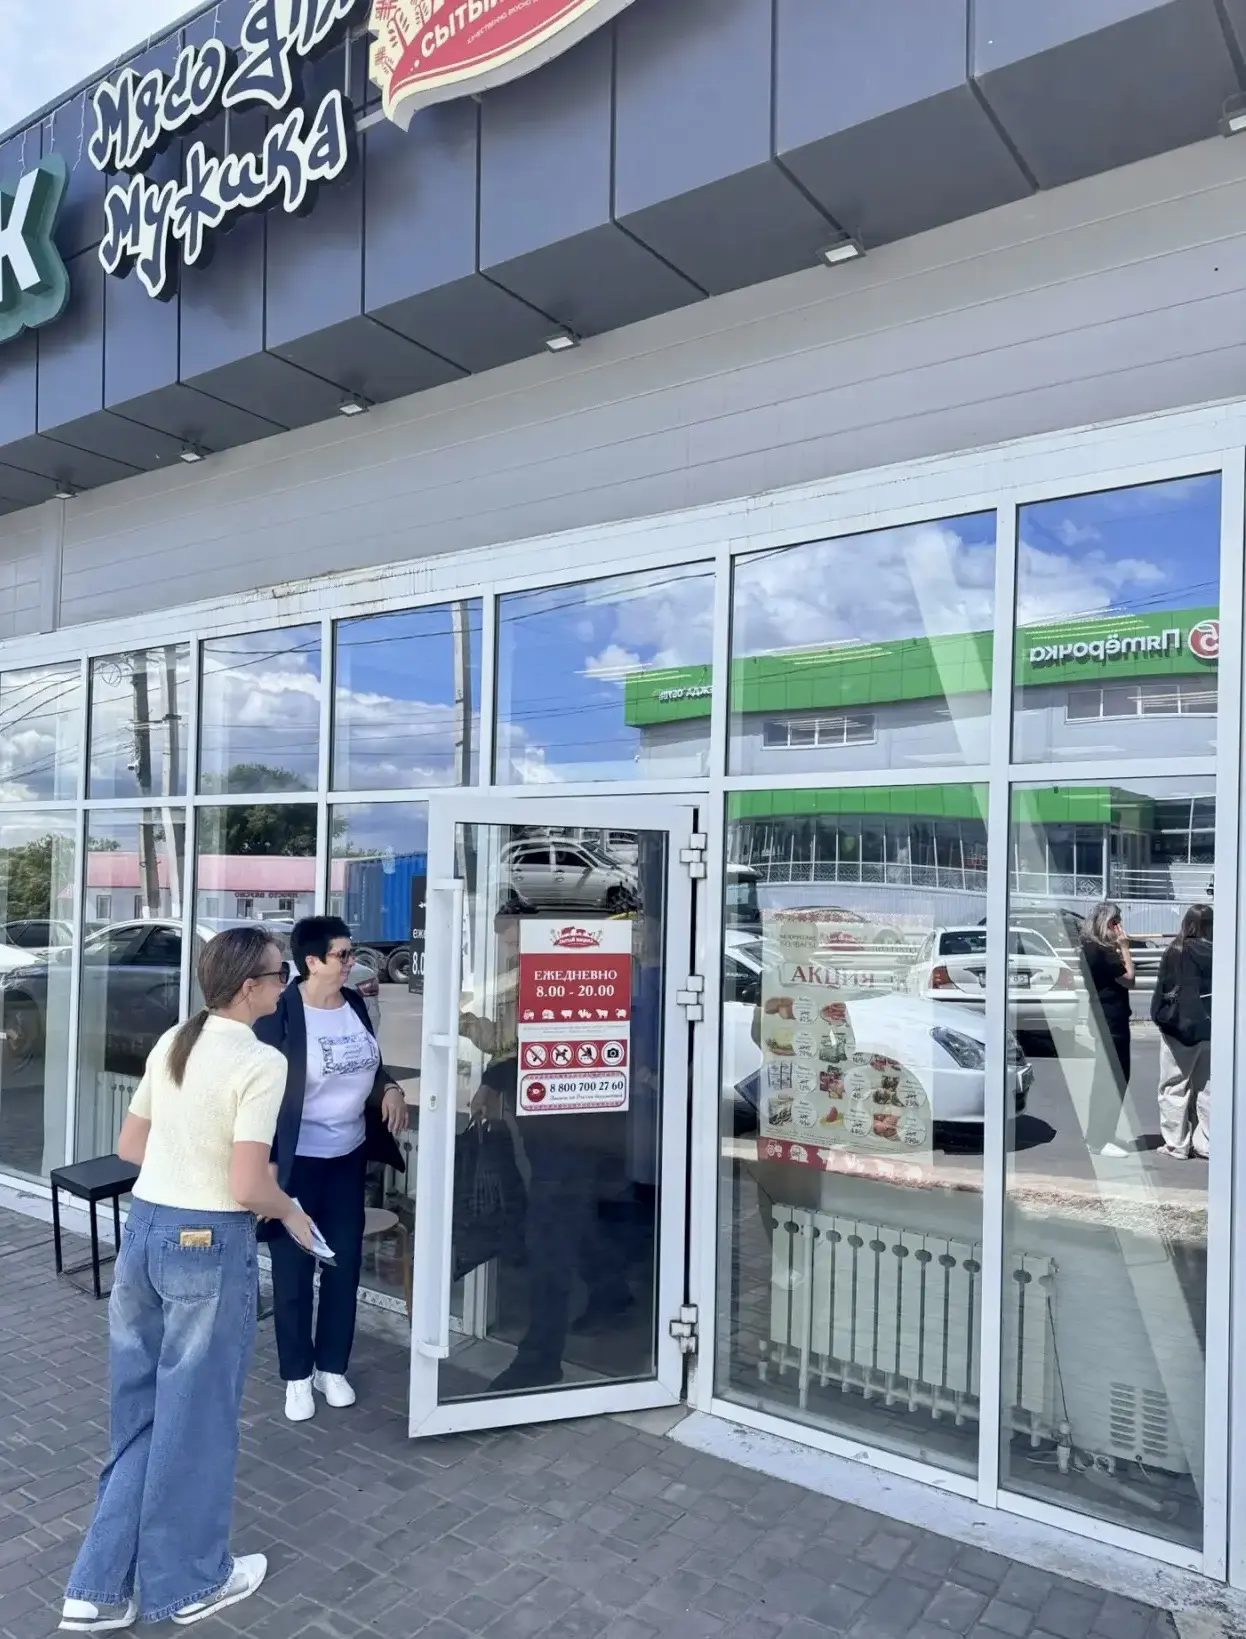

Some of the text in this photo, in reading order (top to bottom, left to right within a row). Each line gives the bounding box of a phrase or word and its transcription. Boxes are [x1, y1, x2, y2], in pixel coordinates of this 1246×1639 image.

[98, 89, 350, 299] Мужика
[534, 969, 618, 982] ЕЖЕДНЕВНО
[791, 965, 875, 988] АКЦИЯ
[536, 985, 565, 997] 8.00
[578, 984, 615, 997] 20.00
[550, 1080, 624, 1093] 8 800 700 27 60
